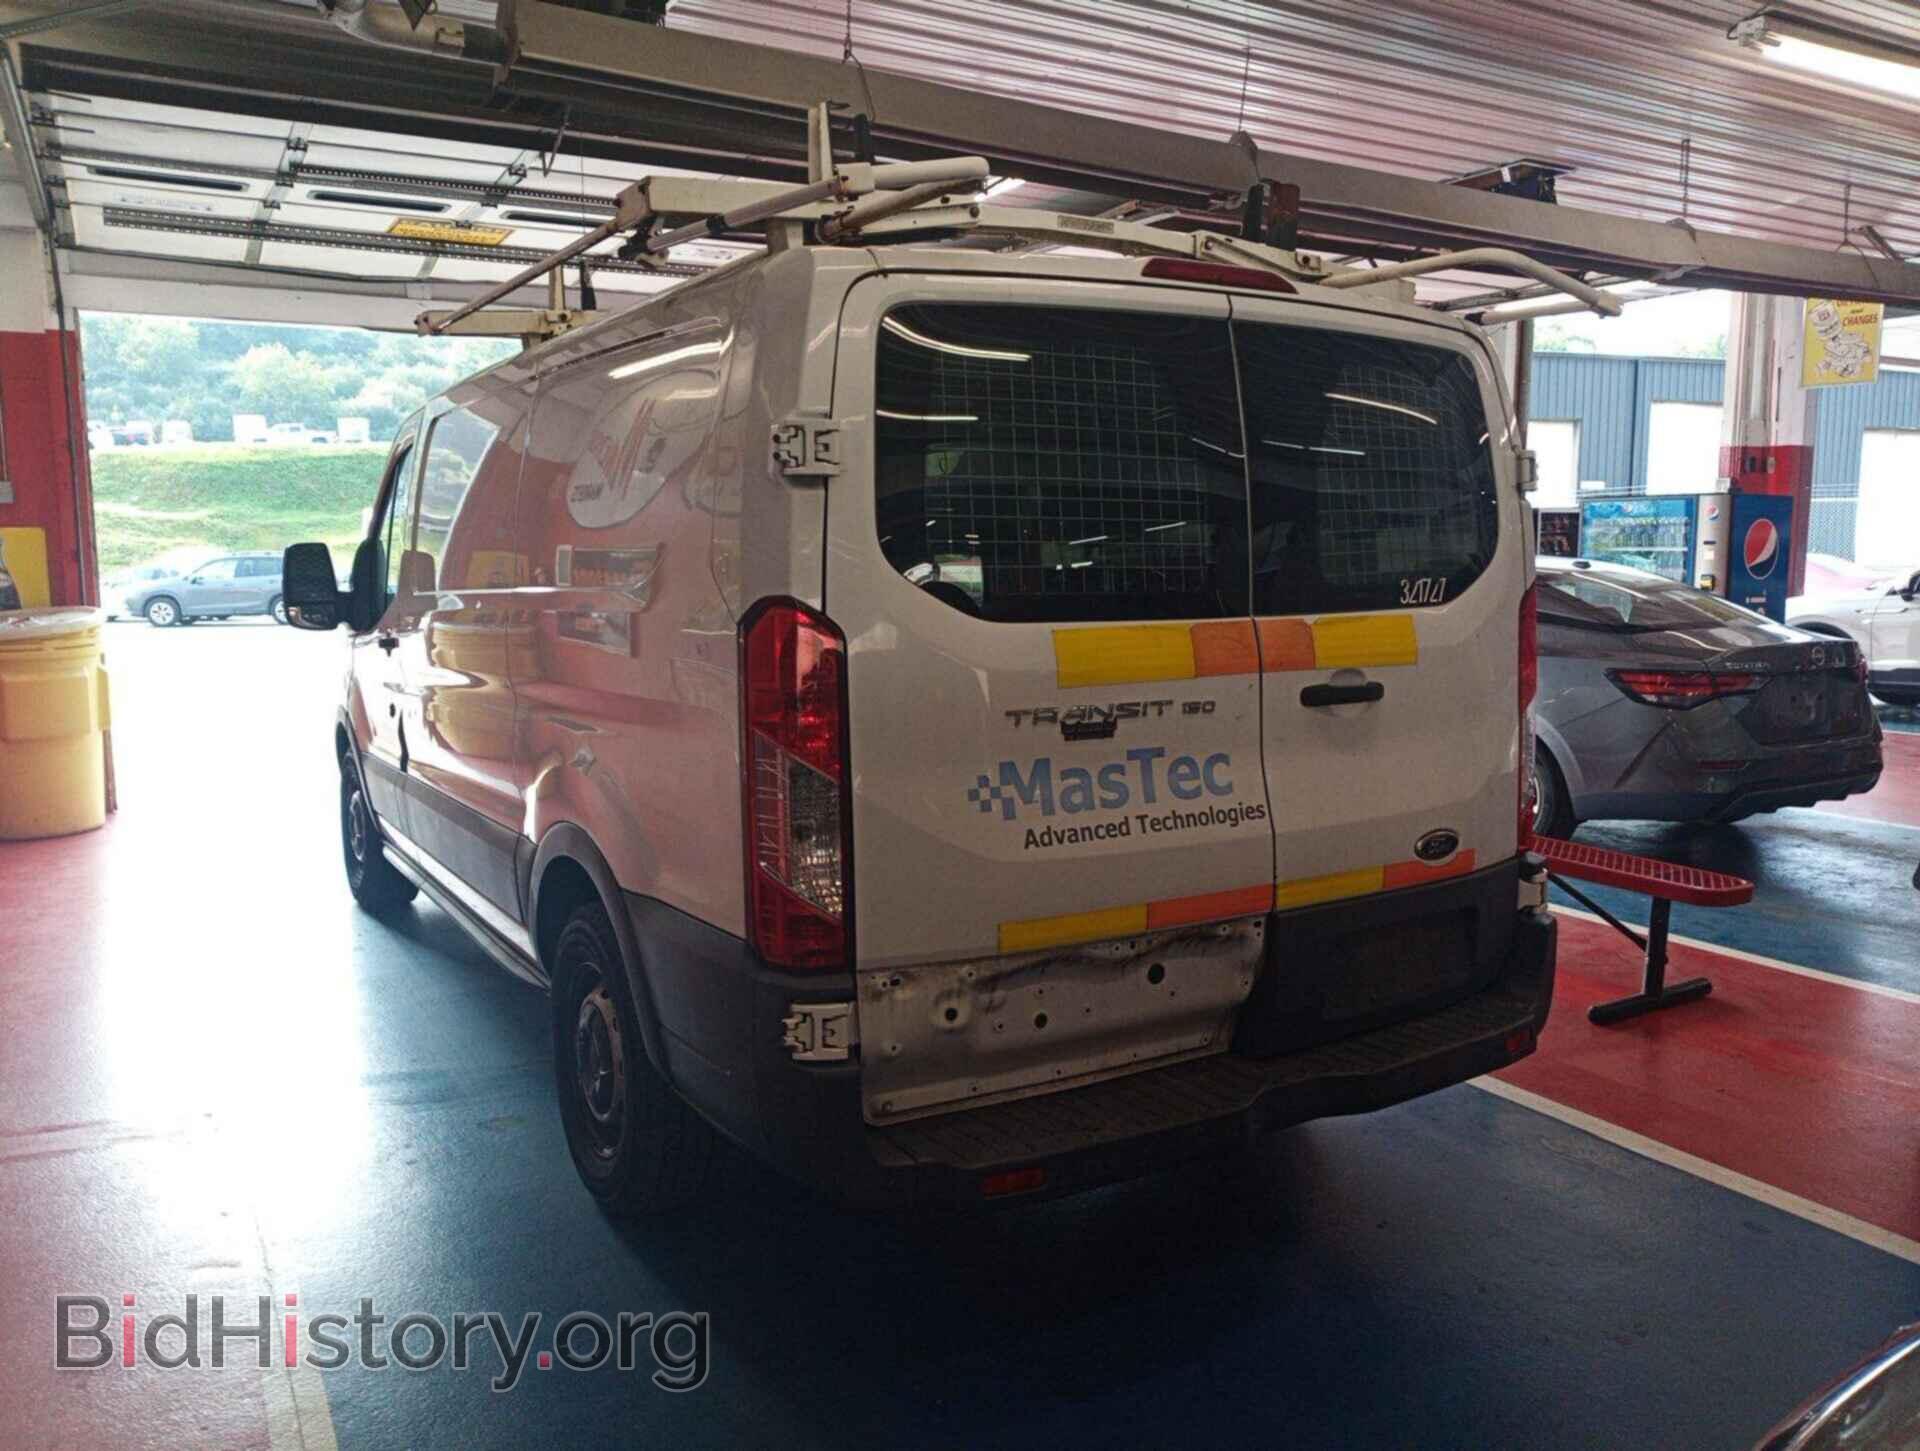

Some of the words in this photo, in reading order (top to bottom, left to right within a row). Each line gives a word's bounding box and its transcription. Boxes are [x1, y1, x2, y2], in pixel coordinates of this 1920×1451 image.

[1004, 699, 1173, 728] TRANSIT
[999, 747, 1234, 820] MasTec
[1024, 816, 1131, 849] Advanced
[1136, 801, 1266, 832] Technologies
